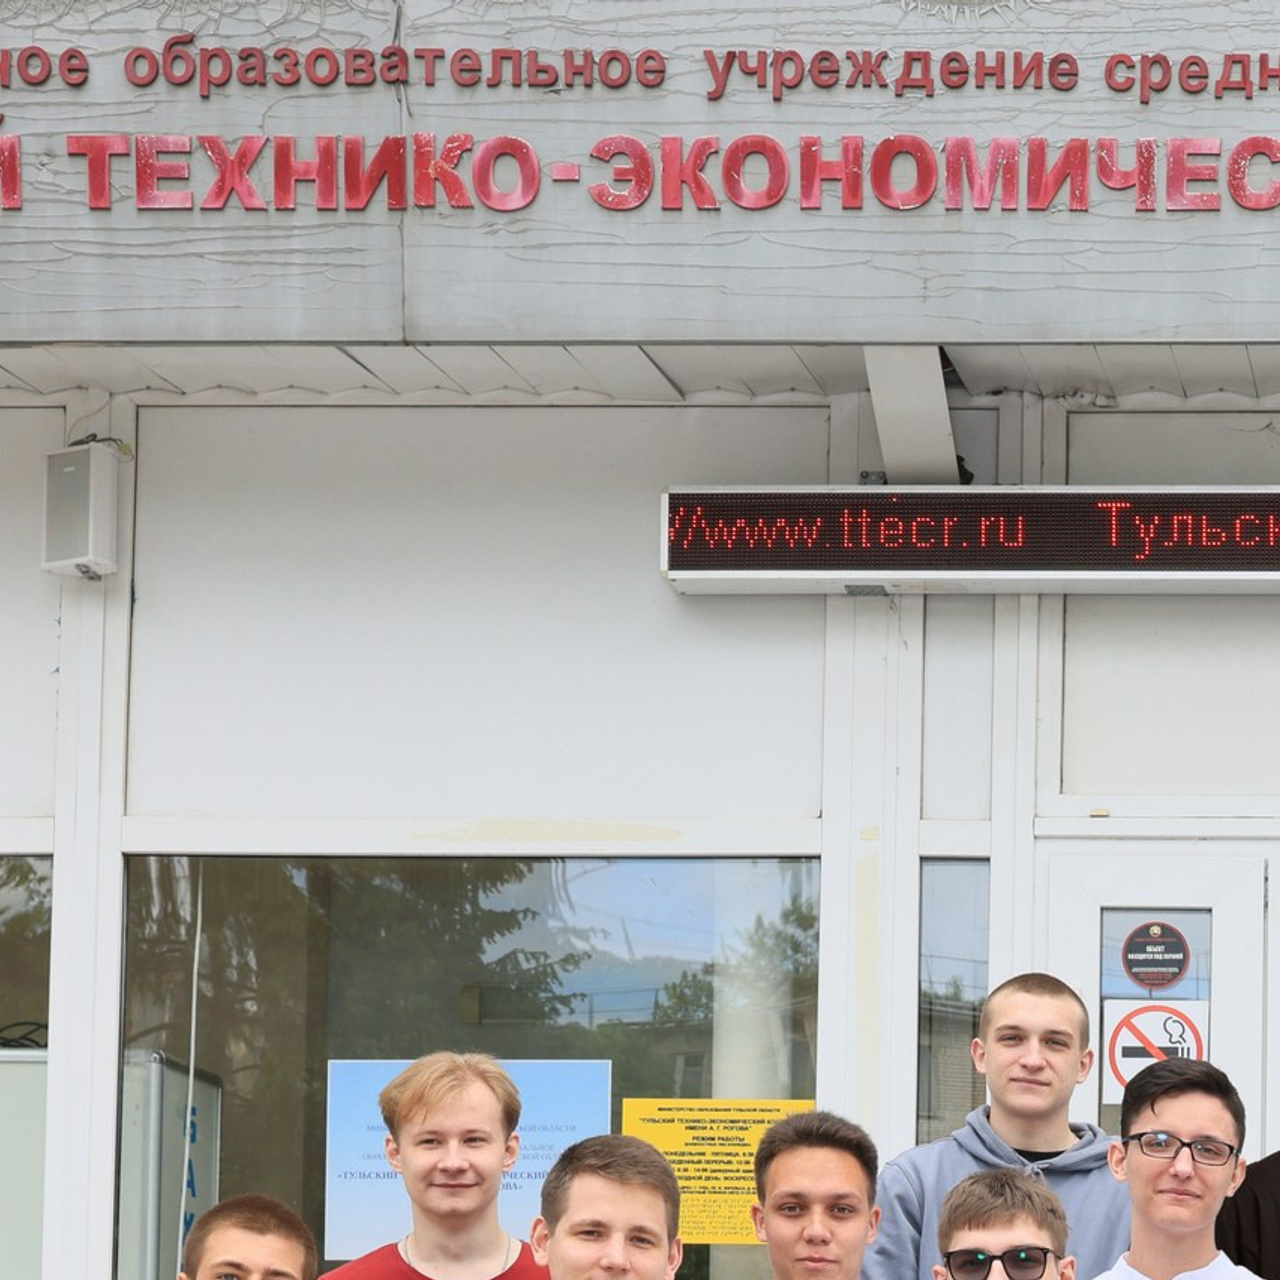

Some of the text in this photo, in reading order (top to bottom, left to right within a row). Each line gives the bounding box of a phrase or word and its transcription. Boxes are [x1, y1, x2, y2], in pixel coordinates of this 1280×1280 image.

[0, 46, 88, 87] ое
[124, 33, 665, 98] образовательное
[705, 48, 1079, 101] учреждение
